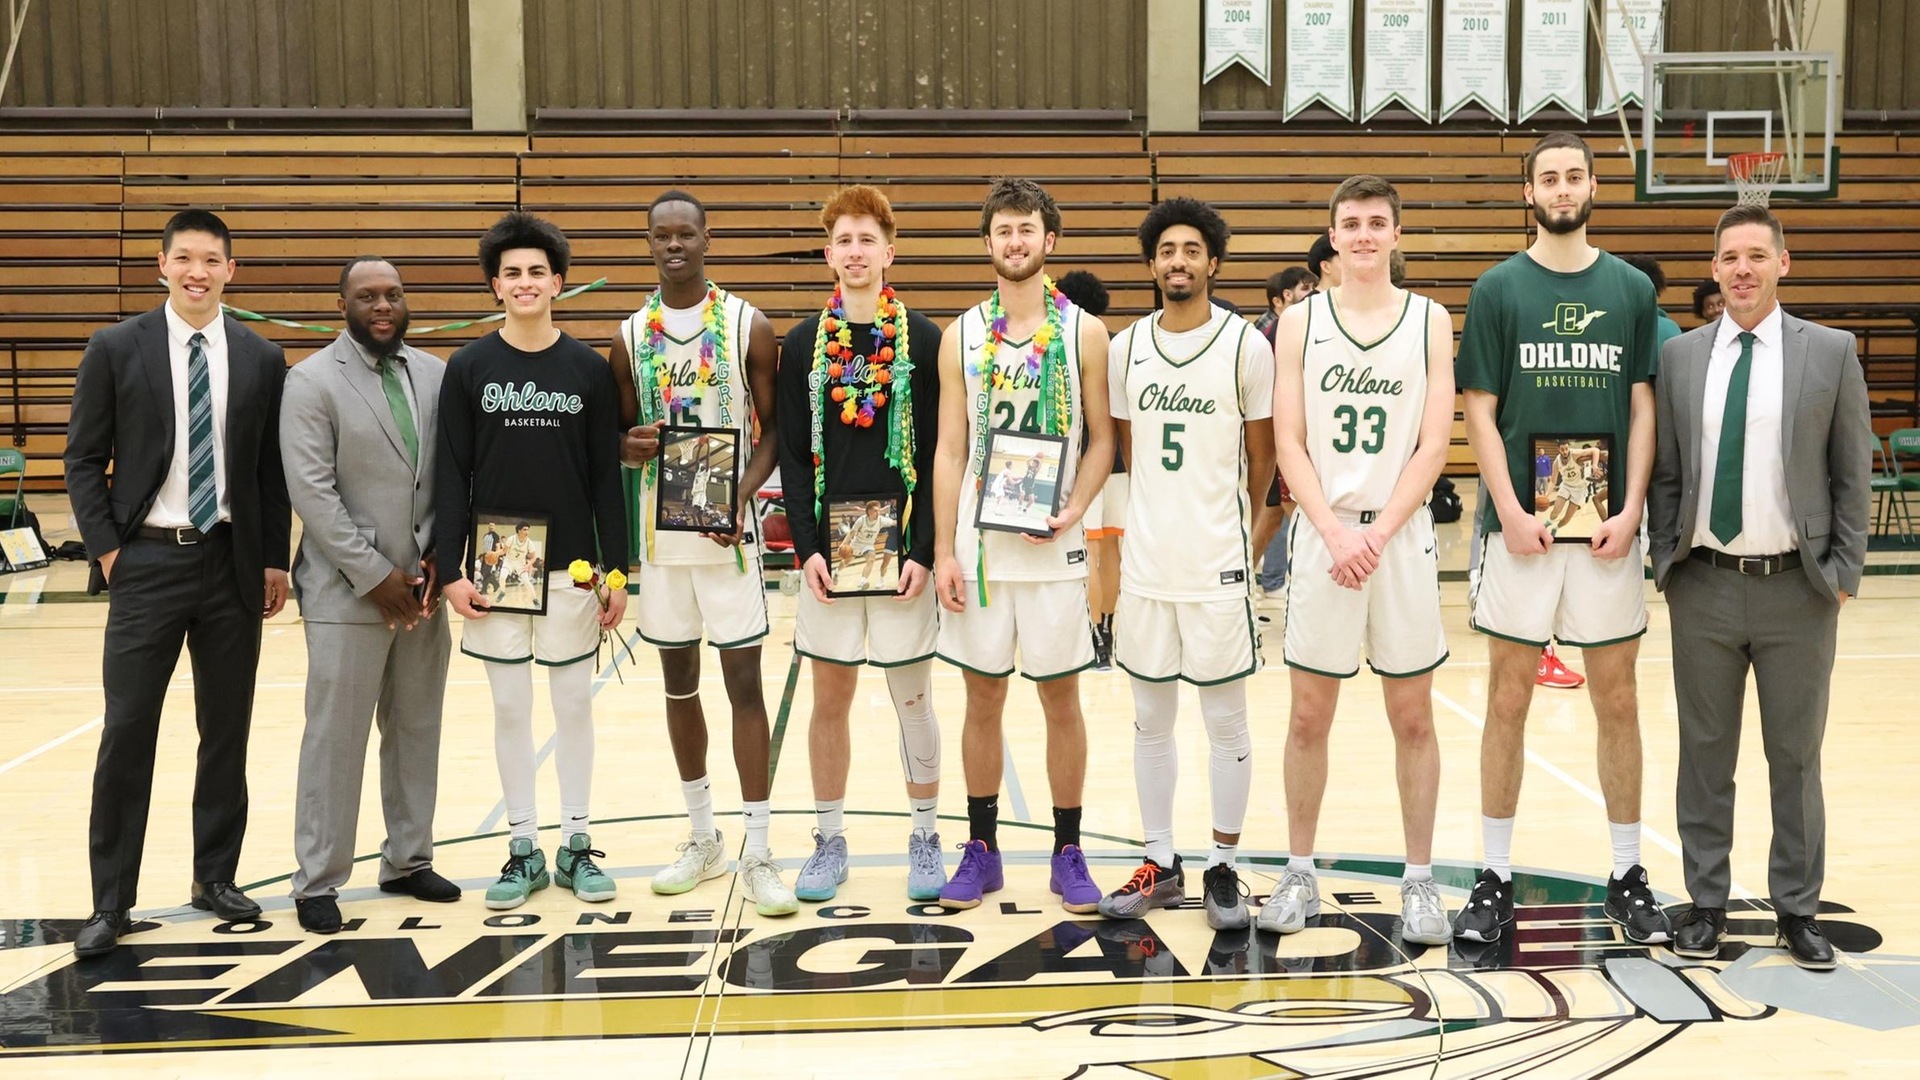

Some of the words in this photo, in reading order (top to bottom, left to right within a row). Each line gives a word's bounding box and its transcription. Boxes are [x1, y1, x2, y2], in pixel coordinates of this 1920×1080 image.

[1224, 10, 1250, 22] 2004
[1305, 13, 1332, 25] 2007
[1382, 14, 1409, 27] 2009
[1463, 18, 1489, 30] 2010
[1542, 12, 1567, 25] 2011
[1519, 342, 1624, 373] OHLONE
[716, 362, 734, 426] GRA
[1320, 363, 1403, 397] Ohlone
[1535, 375, 1608, 389] BASKETBALL
[481, 381, 583, 414] Ohlone
[807, 370, 823, 453] GRAD
[1137, 382, 1216, 415] Ohlone
[504, 418, 561, 428] BASKETBALL
[995, 401, 1041, 433] 24
[1332, 404, 1386, 455] 33
[973, 392, 988, 478] GRAD
[1161, 422, 1184, 472] 5
